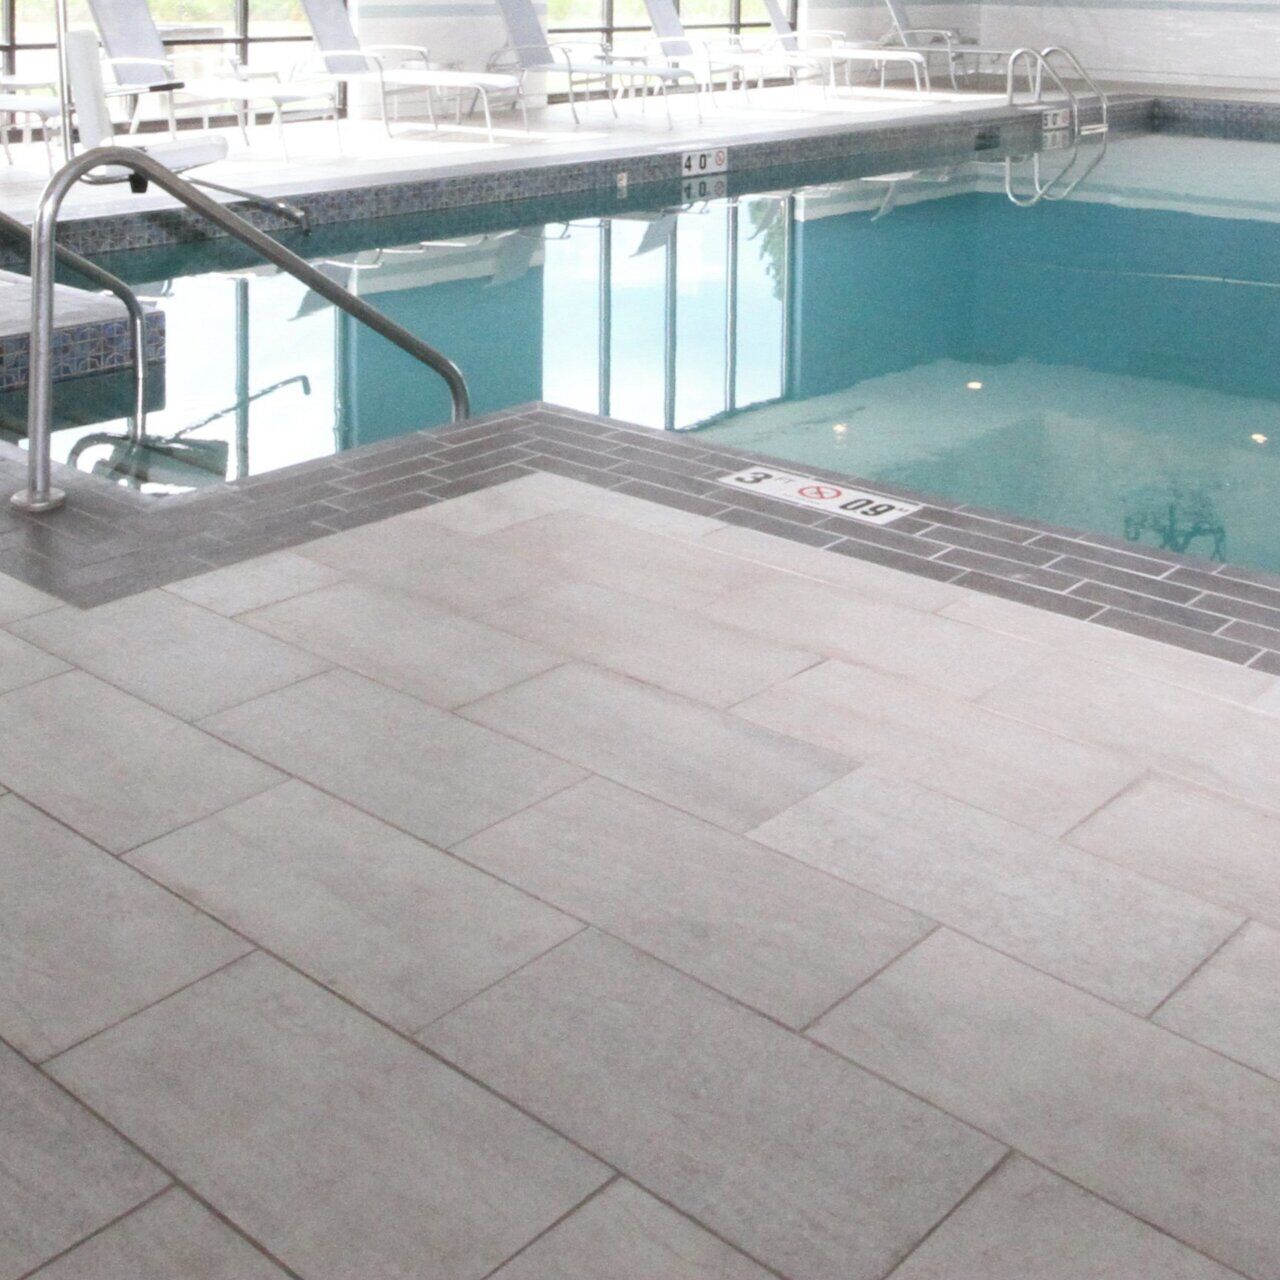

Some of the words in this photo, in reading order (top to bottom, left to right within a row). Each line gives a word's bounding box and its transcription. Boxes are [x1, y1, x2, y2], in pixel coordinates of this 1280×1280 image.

[684, 154, 692, 171] 4
[699, 153, 707, 170] 0
[734, 471, 773, 484] 3
